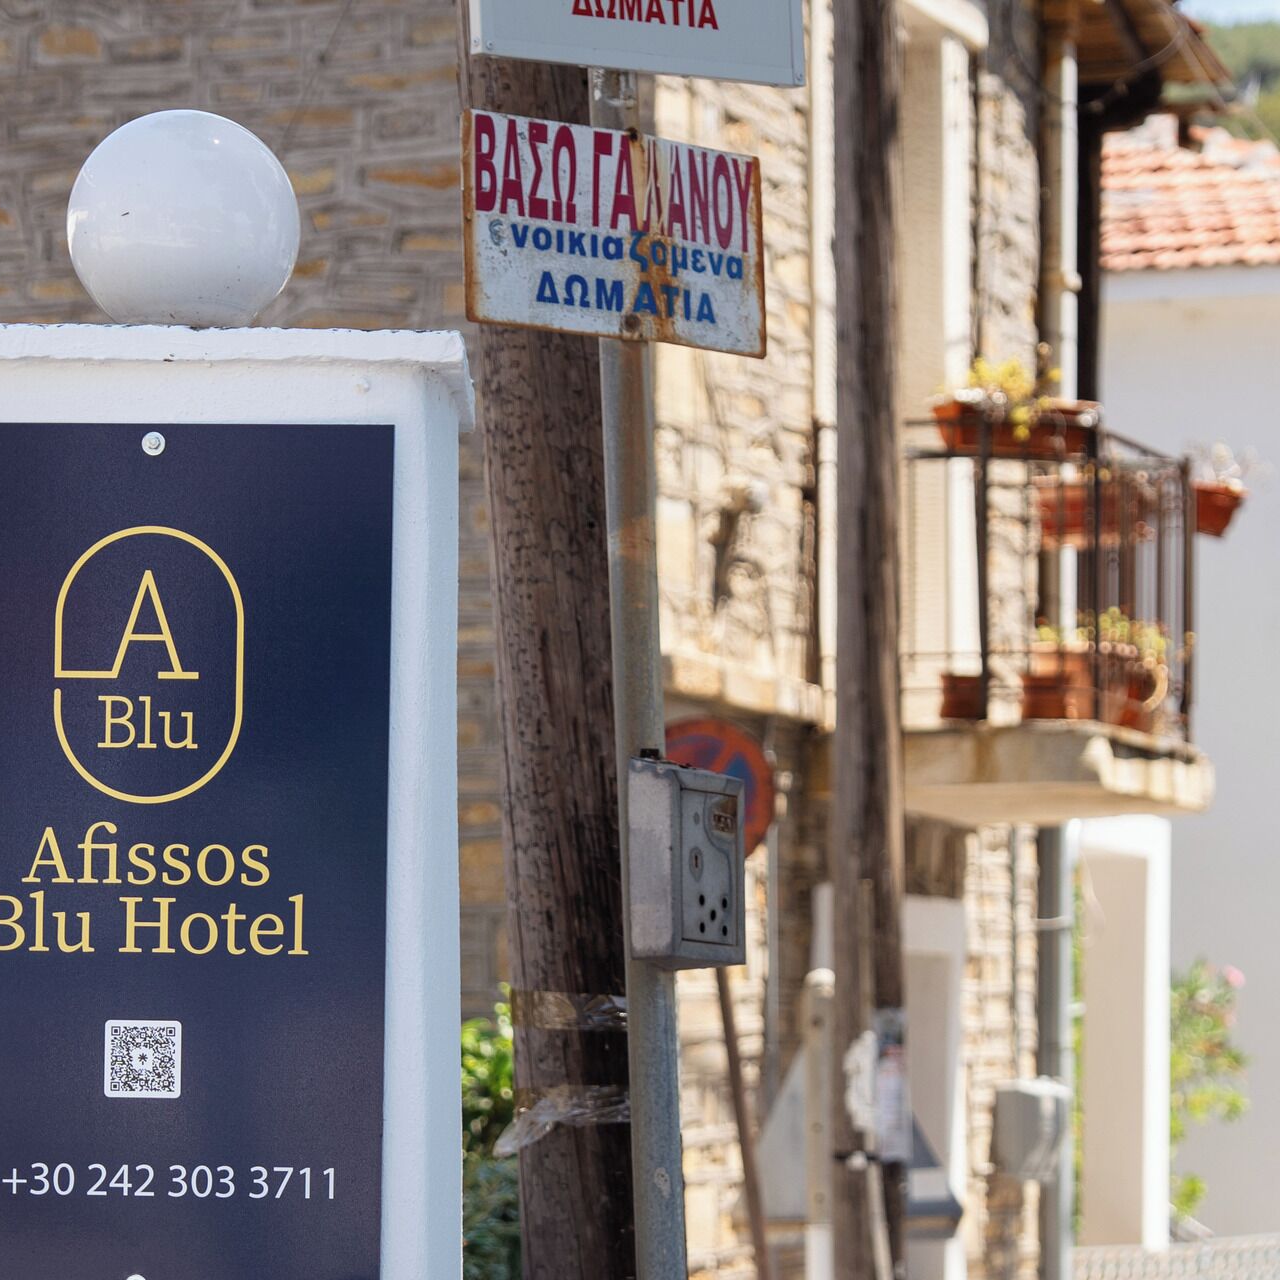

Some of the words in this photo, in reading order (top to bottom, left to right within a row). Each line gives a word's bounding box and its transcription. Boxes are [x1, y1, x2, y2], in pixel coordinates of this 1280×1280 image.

[474, 114, 577, 224] ΒΑΣΩ
[535, 271, 716, 324] ΔΩΜΑΤΙΑ
[111, 570, 199, 679] A
[97, 695, 198, 750] Blu
[22, 821, 270, 887] Afissos
[118, 894, 309, 955] Hotel
[2, 1162, 75, 1197] +30
[87, 1164, 155, 1197] 242
[167, 1165, 235, 1199] 303
[248, 1166, 336, 1200] 3711
